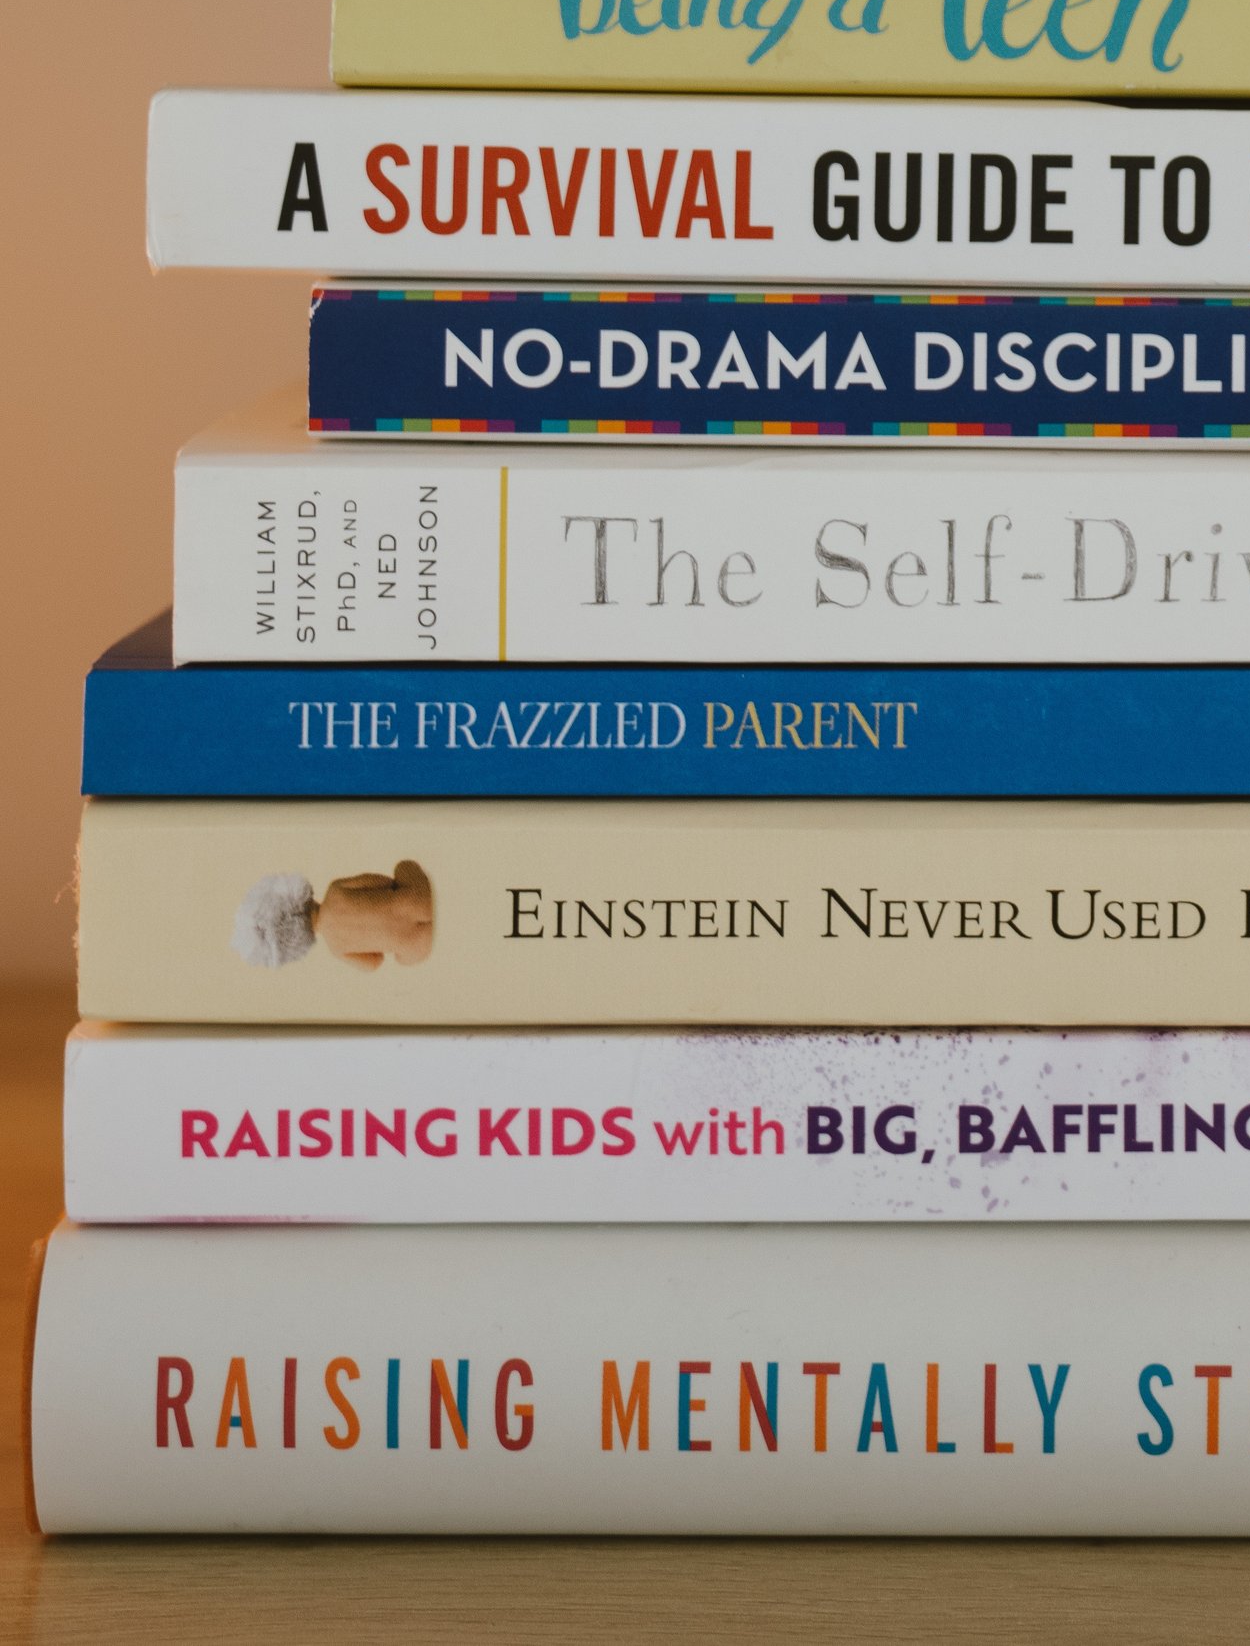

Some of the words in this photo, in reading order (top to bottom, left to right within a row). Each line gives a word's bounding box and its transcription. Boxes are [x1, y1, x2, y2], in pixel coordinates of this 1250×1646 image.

[276, 142, 329, 233] A
[362, 142, 774, 241] SURVIVAL
[812, 150, 1074, 245] GUIDE
[1109, 155, 1211, 247] TO
[444, 328, 887, 391] NO-DRAMA
[342, 499, 358, 548] AND
[564, 516, 762, 608] The
[256, 501, 276, 635] WILLIAM
[295, 490, 321, 644] STIXRUD,
[336, 561, 360, 632] PhD,
[377, 533, 398, 599] NED
[417, 485, 439, 651] JOHNSON
[288, 701, 399, 749] THE
[415, 701, 687, 750] FRAZZLED
[703, 701, 918, 750] PARENT
[181, 1107, 458, 1159] RAISING
[478, 1106, 637, 1157] KIDS
[653, 1106, 785, 1157] with
[806, 1104, 935, 1165] BIG,
[155, 1356, 535, 1452] RAISING
[601, 1360, 1071, 1455] MENTALLY
